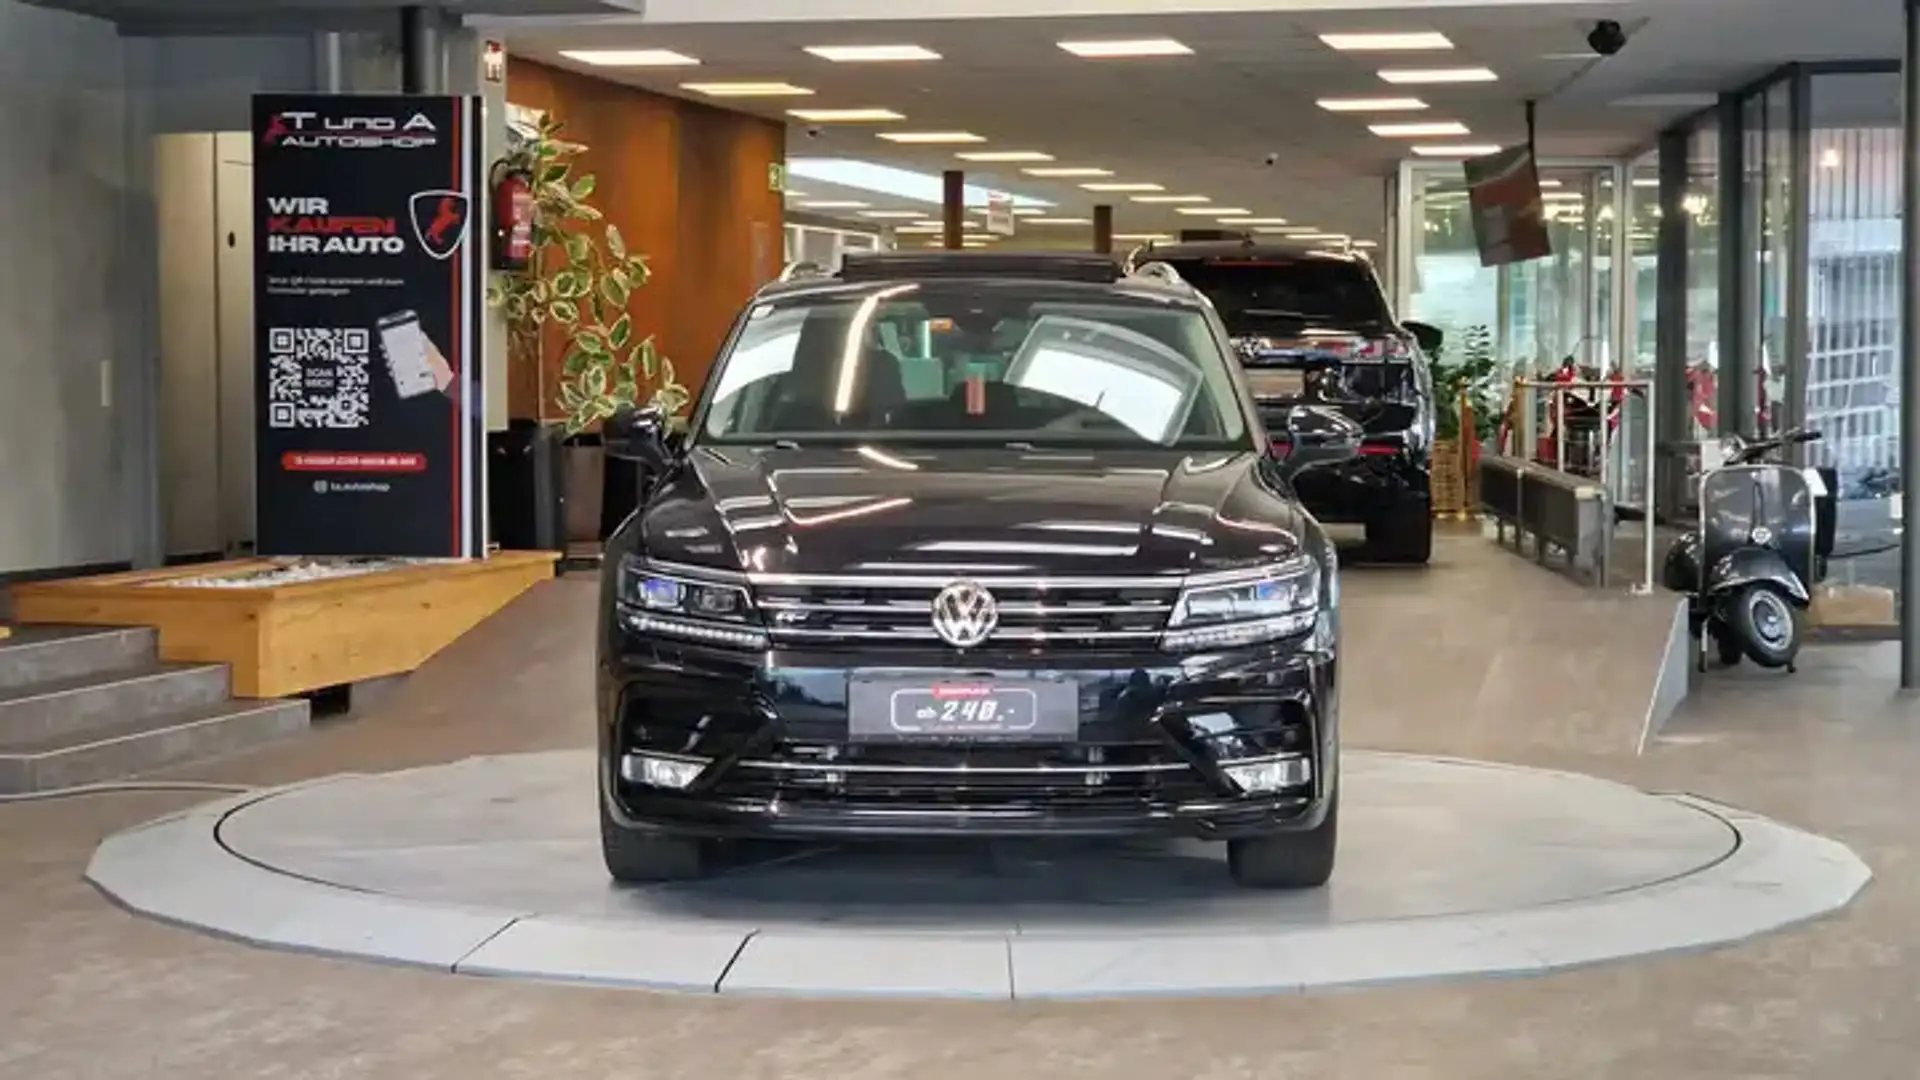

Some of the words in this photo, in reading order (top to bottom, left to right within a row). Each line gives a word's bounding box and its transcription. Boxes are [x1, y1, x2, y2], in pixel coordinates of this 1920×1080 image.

[281, 111, 317, 129] T
[402, 112, 436, 131] A
[281, 136, 437, 148] AUTOSHOP
[267, 197, 329, 215] WIR
[267, 216, 396, 233] KAUFEN
[267, 236, 320, 253] IHR
[323, 236, 404, 253] AUTO
